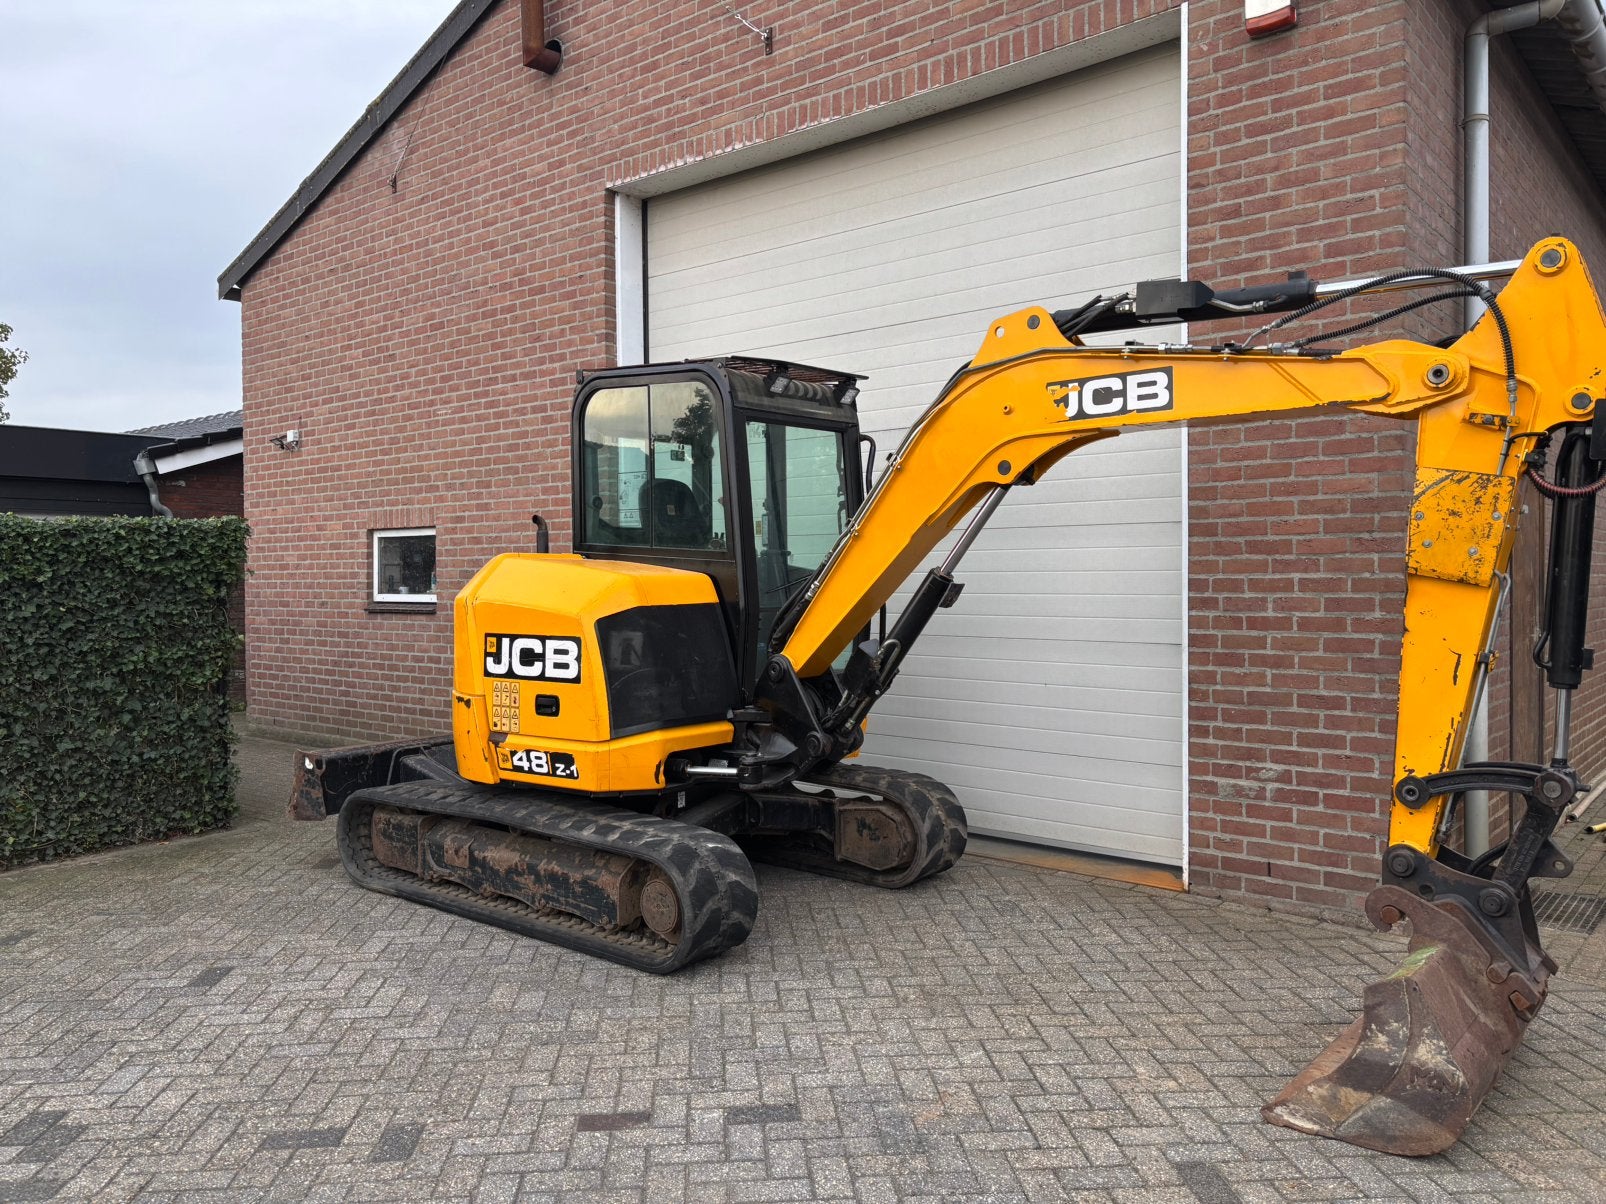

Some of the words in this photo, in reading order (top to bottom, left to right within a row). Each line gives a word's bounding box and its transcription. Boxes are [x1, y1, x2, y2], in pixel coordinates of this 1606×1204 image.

[1055, 372, 1170, 417] JCB
[486, 637, 579, 679] JCB
[512, 751, 549, 773] 48
